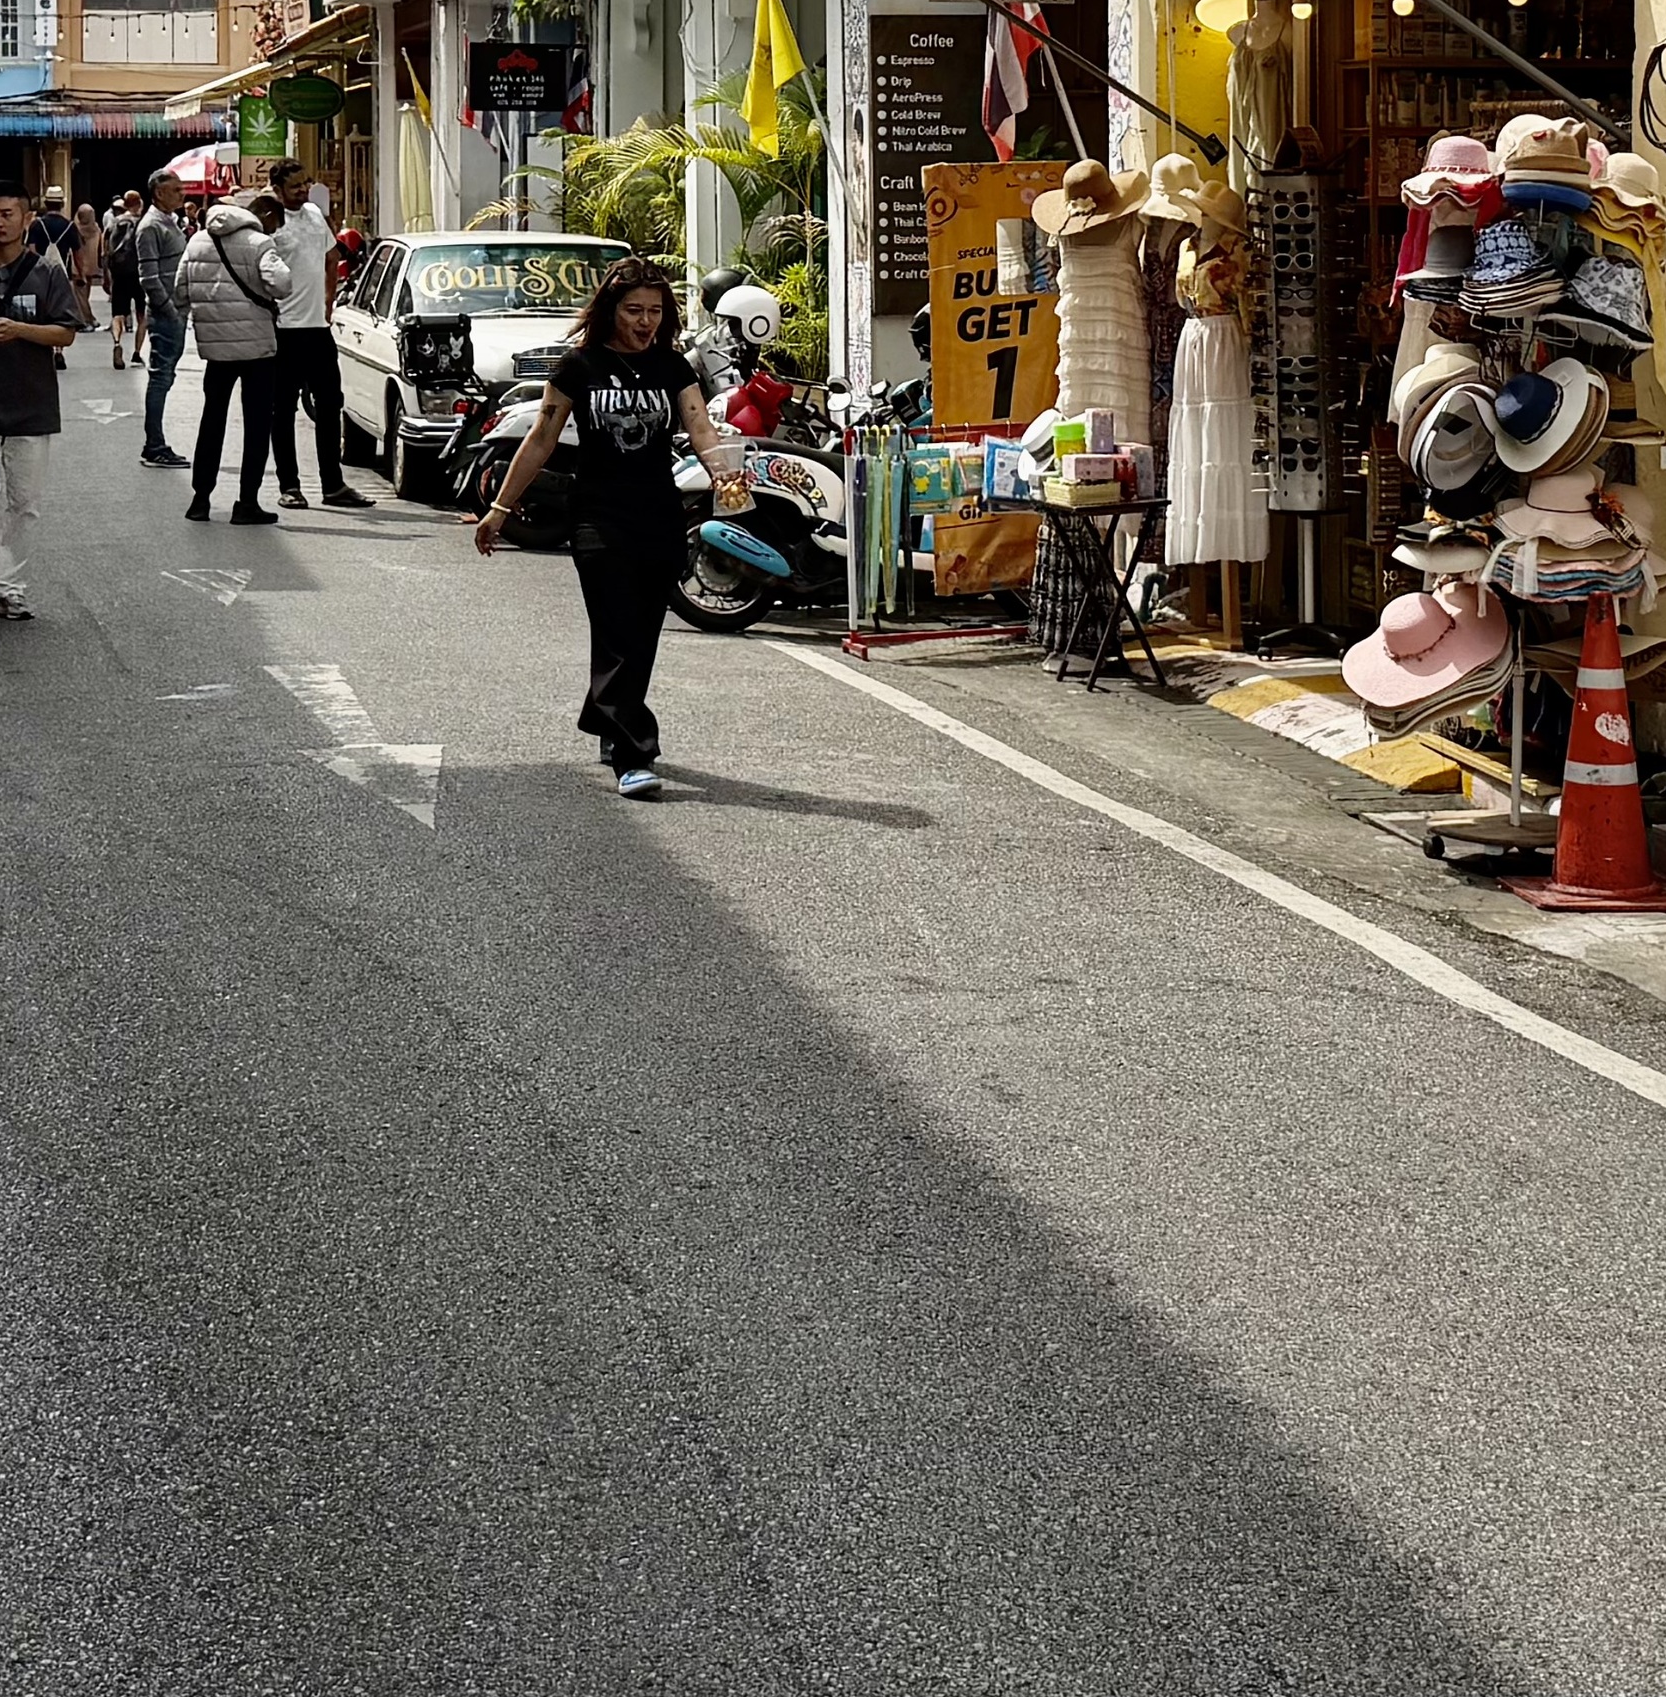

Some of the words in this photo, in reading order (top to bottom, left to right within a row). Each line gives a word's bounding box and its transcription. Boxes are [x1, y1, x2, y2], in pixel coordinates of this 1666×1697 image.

[910, 33, 954, 48] Coffee
[890, 55, 935, 67] Espresso
[891, 76, 912, 88] Drip
[892, 92, 943, 103] AeroPress
[891, 109, 913, 120] Cold
[915, 109, 942, 120] Brew
[892, 126, 916, 136] Nitro
[918, 125, 939, 136] Cold
[941, 125, 967, 136] Brew
[892, 142, 913, 152] Thai
[915, 141, 953, 152] Arabica
[880, 176, 915, 190] Craft
[893, 201, 918, 212] Bean
[894, 217, 914, 227] Thai
[894, 269, 918, 279] Craft
[956, 299, 1038, 343] GET
[986, 346, 1019, 420] 1
[589, 388, 671, 430] NIRVANA
